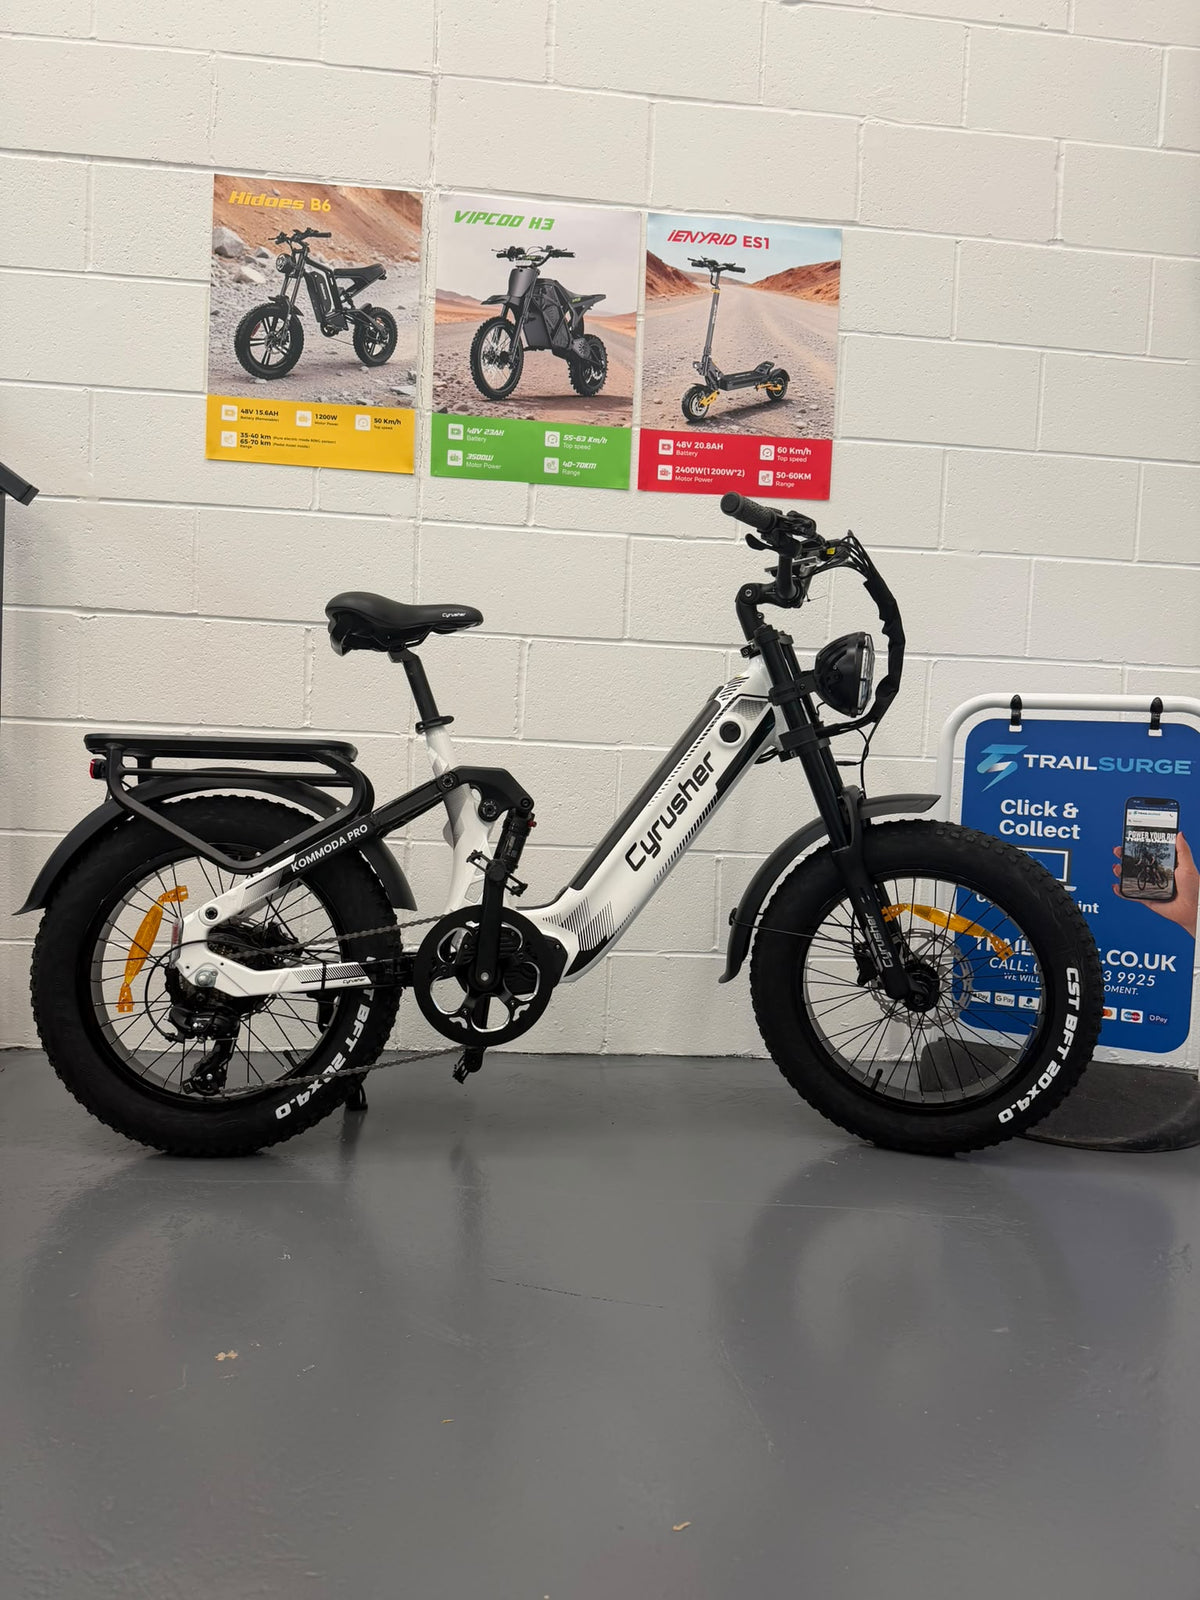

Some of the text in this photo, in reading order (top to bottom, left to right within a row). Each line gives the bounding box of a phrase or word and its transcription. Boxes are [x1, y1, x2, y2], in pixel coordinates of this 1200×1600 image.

[228, 190, 332, 213] Hidoes B6
[453, 210, 556, 231] VIPCOO H3
[742, 235, 770, 250] ES1
[255, 409, 279, 417] 15.6AH
[314, 413, 338, 421] 1200W
[466, 428, 482, 436] 48V
[466, 435, 487, 444] Battery
[563, 434, 608, 445] 55-63 Km/h
[563, 442, 591, 451] Top speed
[676, 441, 724, 451] 48V 20.8AH
[777, 446, 812, 456] 60 Km/h
[466, 453, 494, 462] 3500W
[676, 450, 698, 458] Battery
[789, 456, 807, 464] speed
[466, 461, 501, 470] Motor Power
[562, 468, 581, 477] Range
[775, 472, 812, 481] 50-60KM
[693, 476, 713, 484] Power
[775, 481, 795, 489] Range
[1023, 754, 1192, 775] TRAILSURGE
[624, 750, 716, 872] Cyrusher
[1000, 799, 1080, 819] Click &
[999, 819, 1081, 840] Collect
[290, 824, 368, 873] KOMMODA PRO
[1077, 900, 1100, 914] int
[989, 957, 1029, 972] CALL:
[1019, 974, 1040, 984] WILL
[1117, 971, 1156, 987] 9925
[1066, 967, 1081, 1011] CST
[1103, 985, 1139, 996] OMENT.
[345, 1003, 371, 1053] BFT
[1056, 1013, 1079, 1061] BFT
